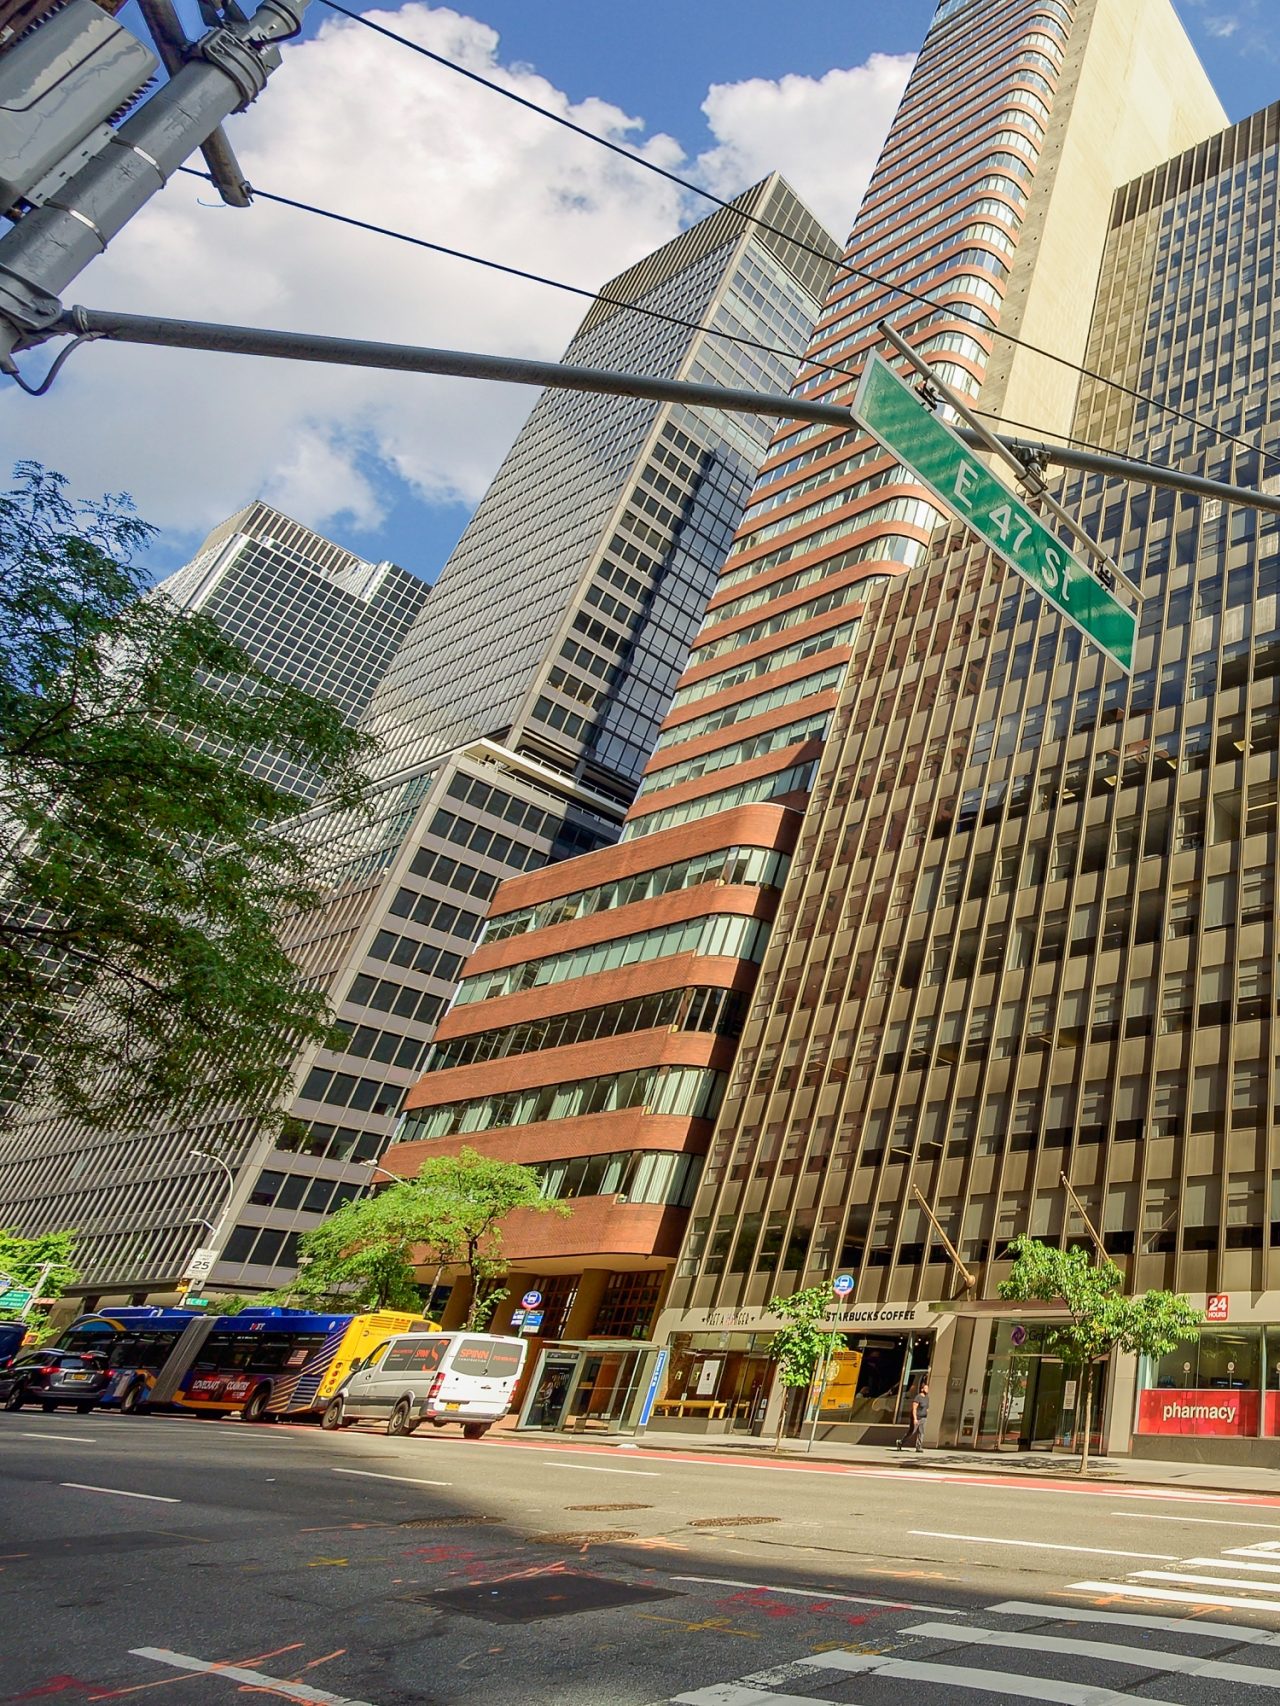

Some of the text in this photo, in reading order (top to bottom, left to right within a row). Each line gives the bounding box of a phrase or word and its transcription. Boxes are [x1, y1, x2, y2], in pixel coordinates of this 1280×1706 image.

[953, 460, 1071, 601] E 47 St
[192, 1260, 210, 1270] 25
[1208, 1297, 1227, 1311] 24
[880, 1310, 916, 1321] COFFEE
[1208, 1311, 1227, 1319] HOURS
[460, 1348, 490, 1360] SPINN
[226, 1381, 251, 1391] COUNTRY
[1162, 1402, 1237, 1424] pharmacy
